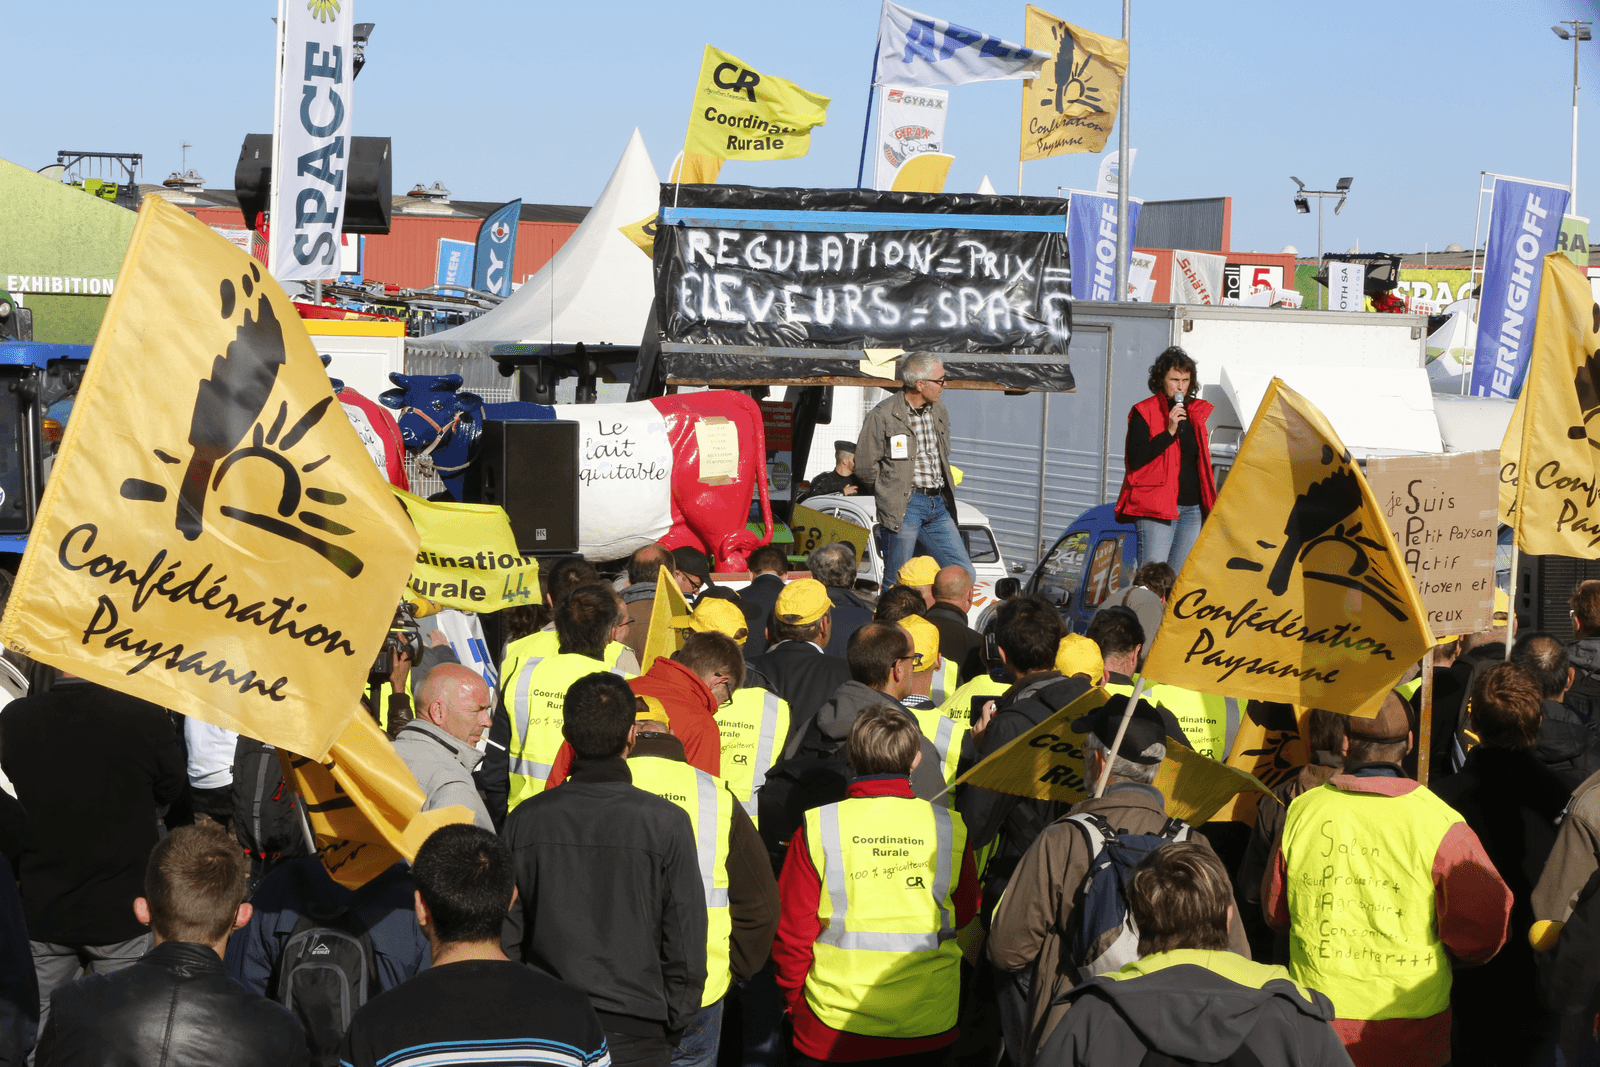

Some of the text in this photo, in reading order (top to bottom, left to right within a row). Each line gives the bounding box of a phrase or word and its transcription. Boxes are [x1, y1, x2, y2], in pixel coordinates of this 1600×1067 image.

[713, 62, 760, 103] CR
[902, 95, 945, 110] GYRAX
[704, 106, 796, 135] Coordina
[727, 135, 784, 150] Rurale
[894, 127, 931, 139] GYRAX
[292, 41, 345, 266] SPACE
[687, 230, 934, 275] REGULATION
[958, 240, 1034, 282] PRIX
[7, 275, 114, 295] EXHIBITION
[681, 272, 901, 326] ELEVEURS
[938, 286, 1073, 340] SPACE
[598, 420, 628, 436] Le
[586, 437, 636, 460] lait
[579, 461, 669, 487] quitable
[1405, 480, 1455, 514] Suis
[1450, 525, 1492, 541] Paysan
[1405, 549, 1460, 573] Actif
[58, 523, 355, 657] Confédération
[502, 573, 531, 602] 44
[1412, 575, 1488, 595] itoyen et
[1173, 588, 1396, 661] Confédération
[82, 594, 288, 702] Paysanne
[1184, 628, 1340, 683] Paysanne
[720, 741, 755, 755] griculteurs
[1199, 749, 1215, 760] CR
[732, 754, 748, 766] CR
[852, 836, 924, 845] Coordination
[1321, 820, 1380, 857] Salon
[872, 848, 910, 857] Rurale
[850, 860, 929, 881] 100 % agriculteurs
[906, 877, 926, 890] CR
